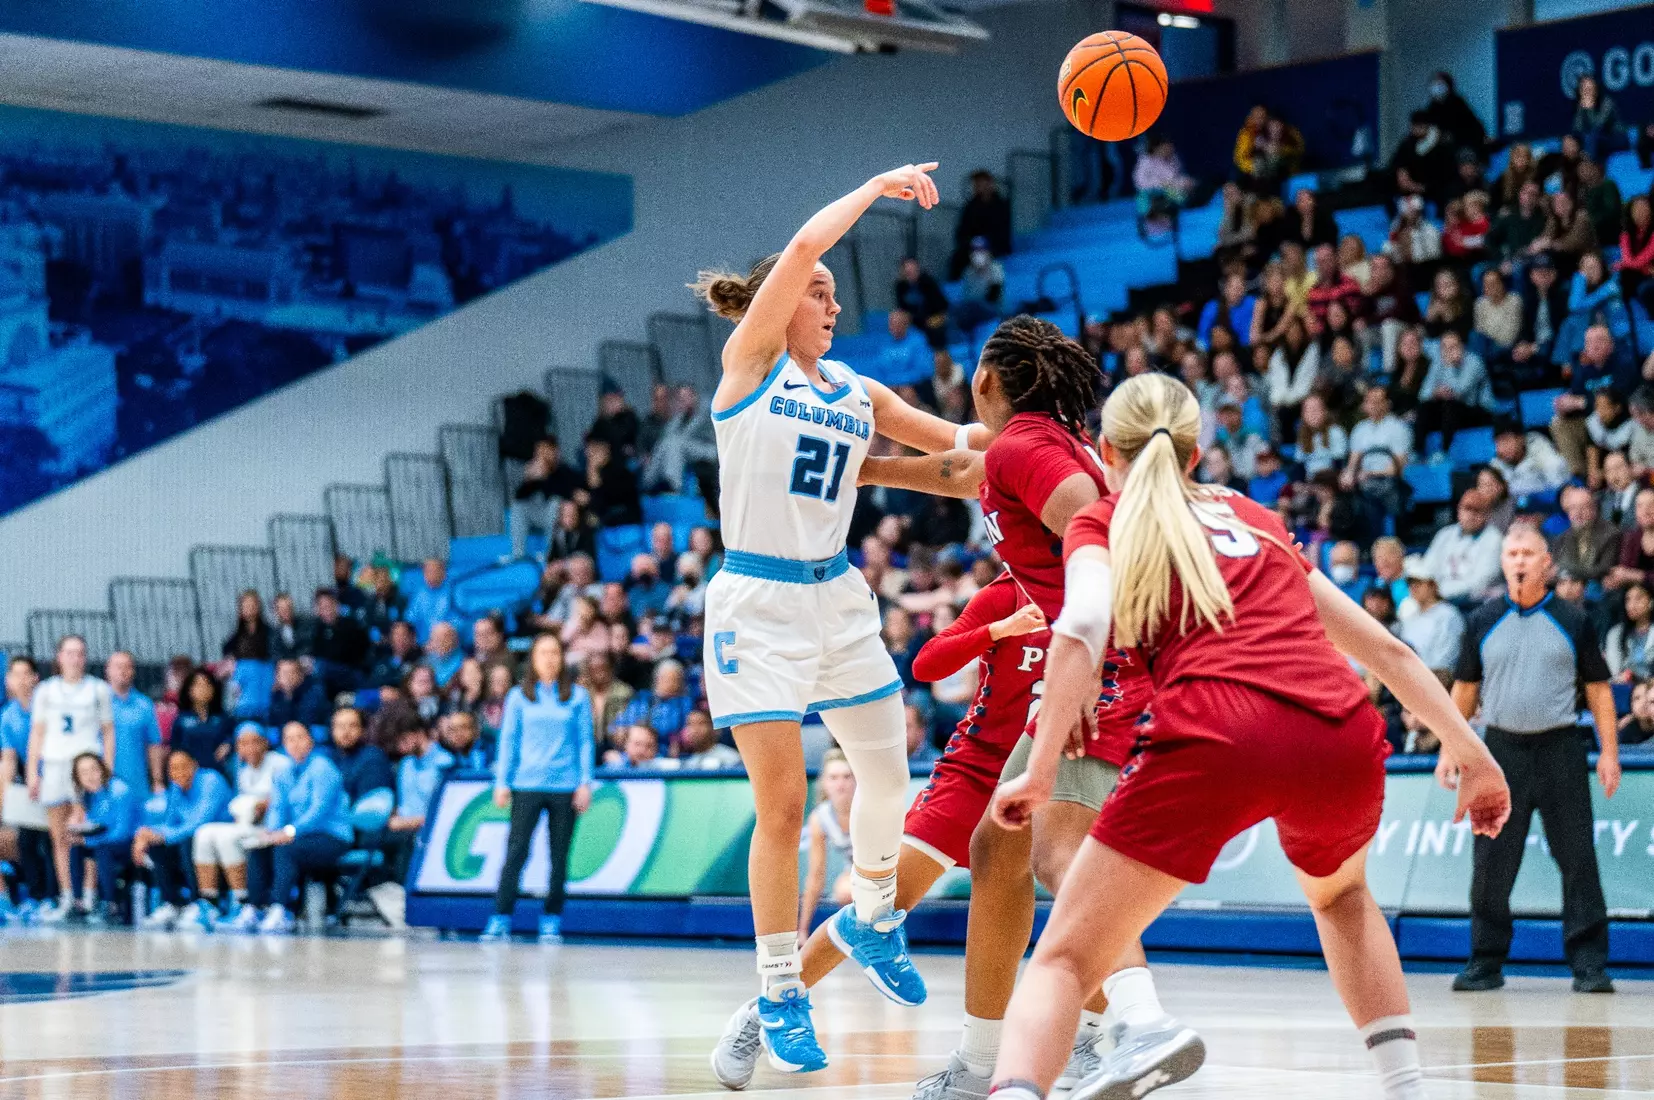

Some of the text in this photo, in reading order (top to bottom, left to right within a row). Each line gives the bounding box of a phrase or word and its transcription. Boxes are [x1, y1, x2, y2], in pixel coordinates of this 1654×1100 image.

[770, 396, 869, 440] COLUMBIA
[789, 434, 851, 502] 21
[1187, 500, 1261, 557] 5
[714, 631, 739, 674] C
